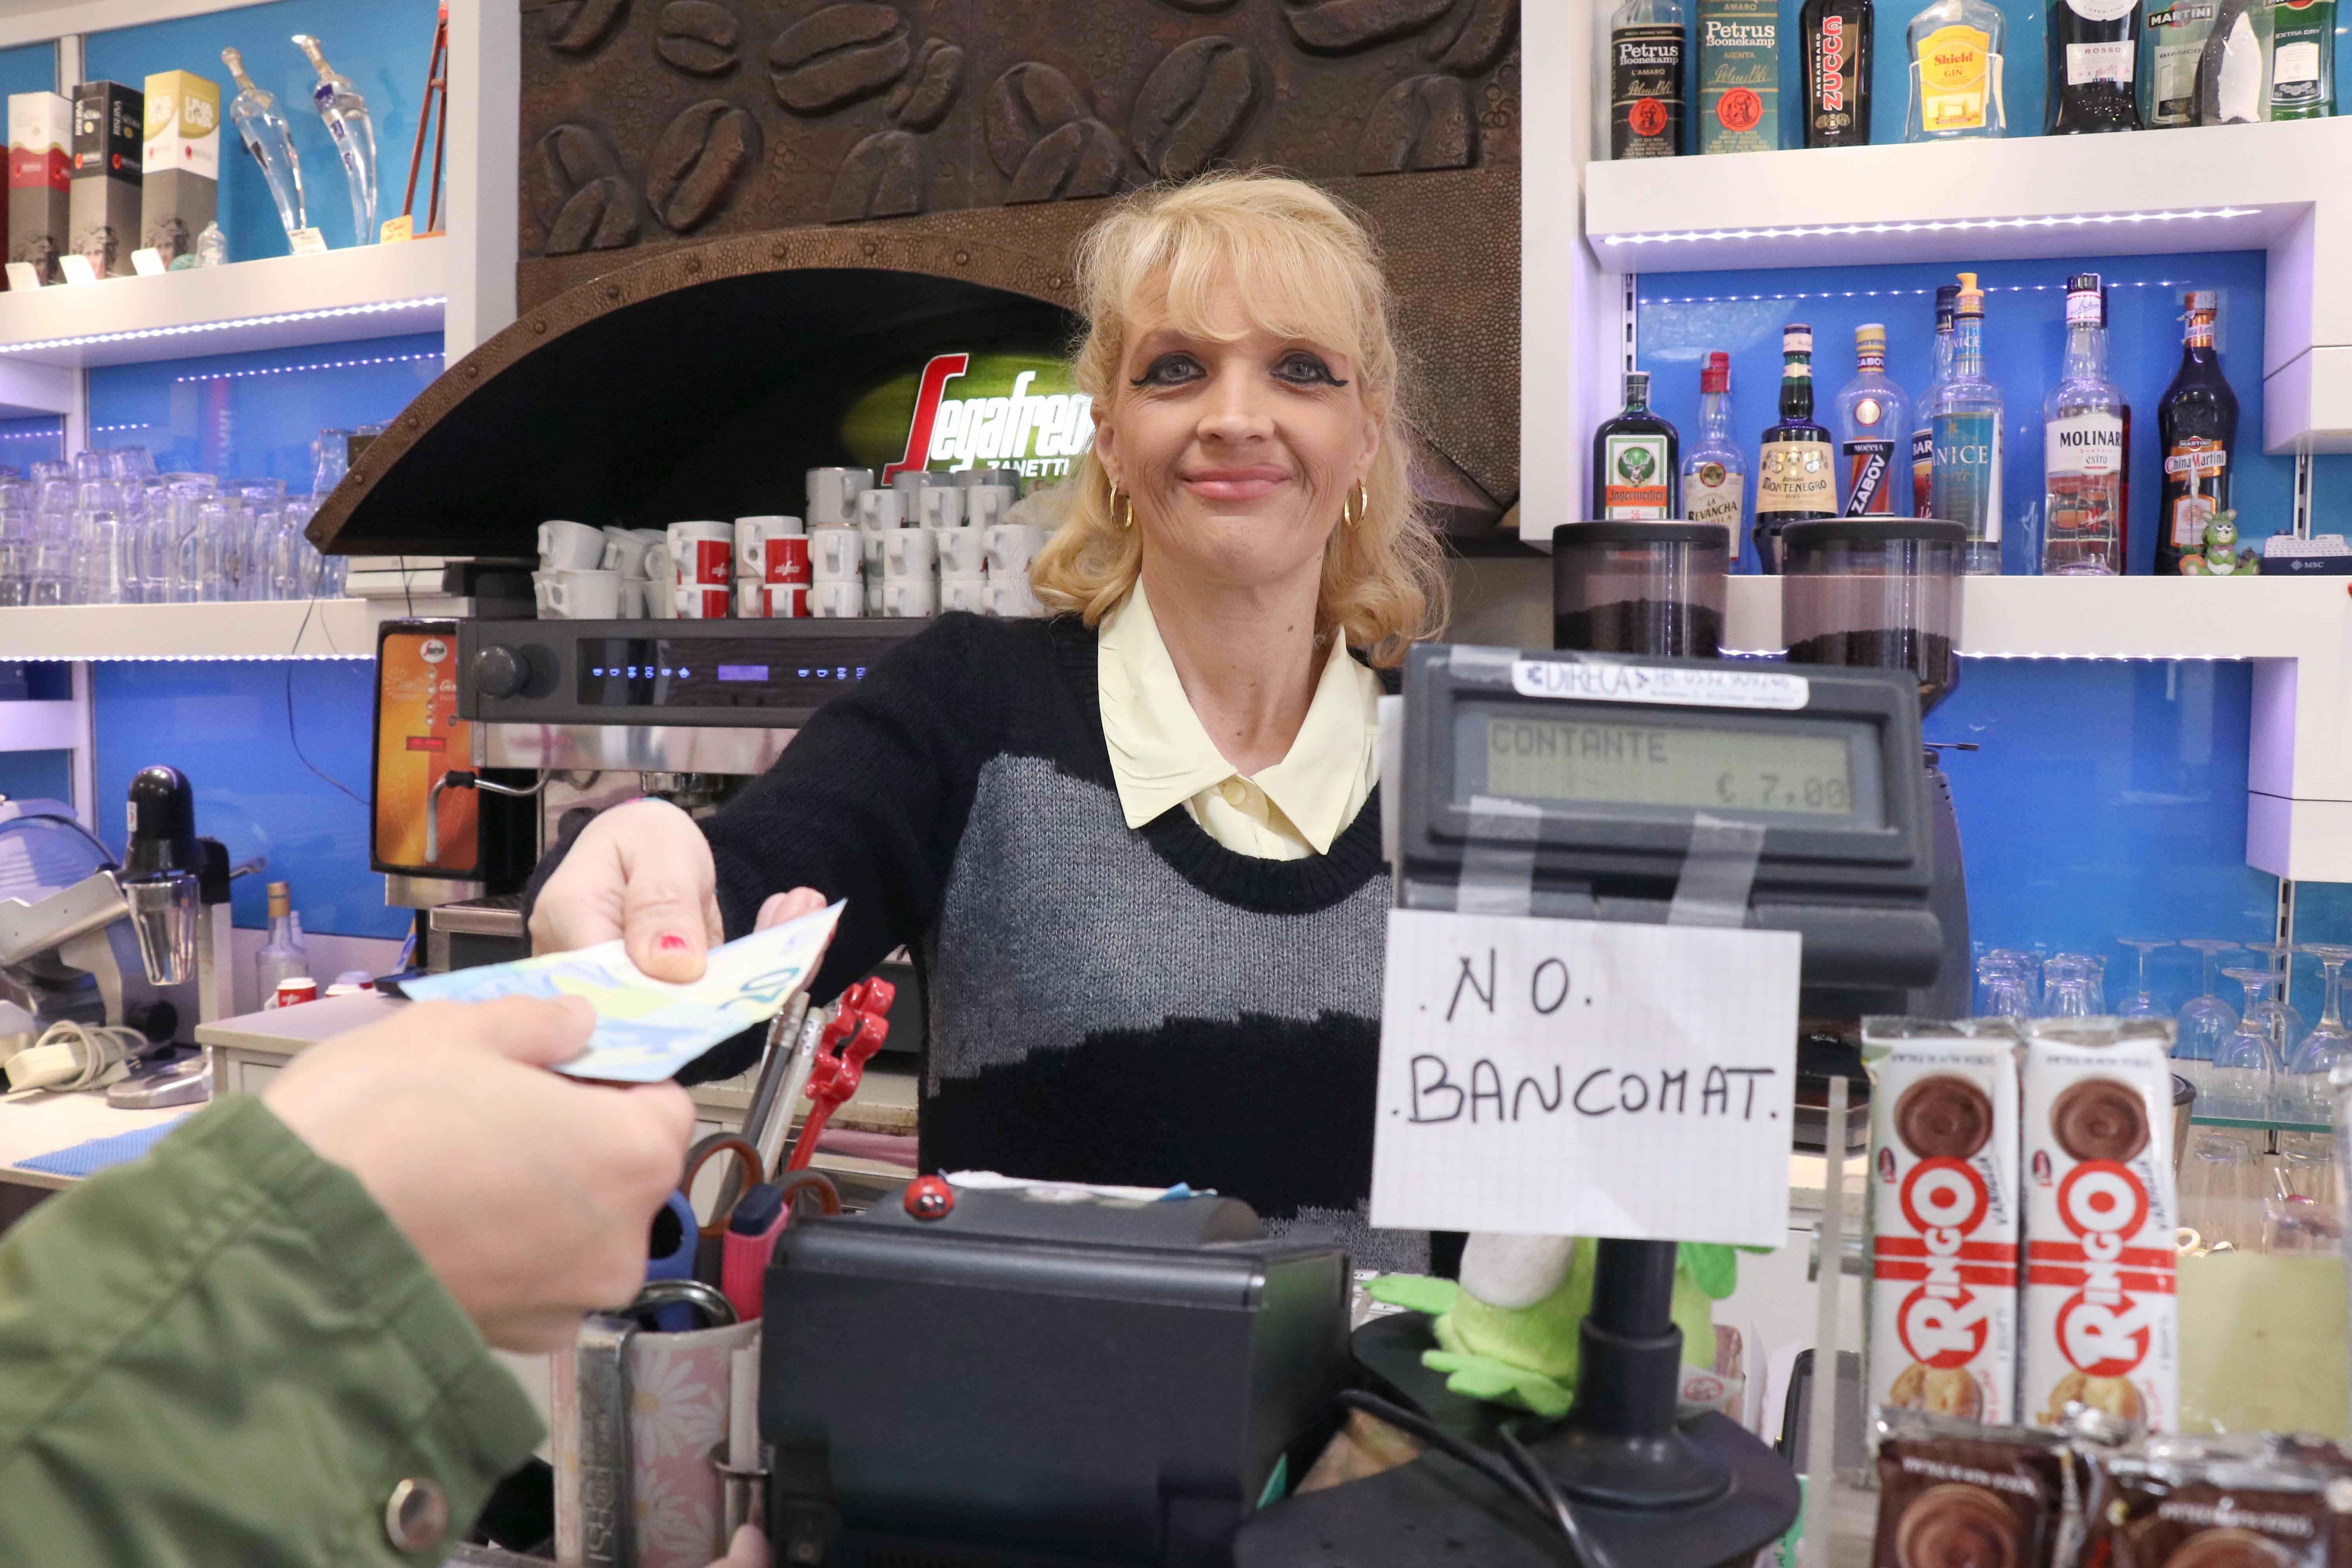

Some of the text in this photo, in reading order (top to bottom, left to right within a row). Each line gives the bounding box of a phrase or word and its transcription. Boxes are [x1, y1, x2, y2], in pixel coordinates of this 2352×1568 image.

[2151, 7, 2210, 26] MARTINI
[1706, 21, 1775, 38] Petrus
[2276, 29, 2302, 38] EXTRA
[1706, 37, 1775, 48] Boonekamp
[1619, 44, 1679, 58] Petrus
[1935, 52, 1973, 65] Shield
[2160, 48, 2201, 59] BIANCO
[1619, 56, 1679, 66] Boonekamp
[1823, 16, 1843, 111] ZUCCA
[1944, 69, 1962, 77] GIN
[881, 353, 1096, 486] Segafred
[1913, 440, 1933, 456] BAR
[2086, 455, 2107, 464] extra
[1762, 477, 1826, 492] MONTENEGRO
[1851, 454, 1885, 514] ZABOV
[1706, 498, 1716, 506] LA
[1688, 501, 1737, 520] REVANCHA
[1492, 719, 1666, 763] CONTANTE
[1898, 1158, 1987, 1367] RINGO
[2056, 1160, 2148, 1376] RINGO
